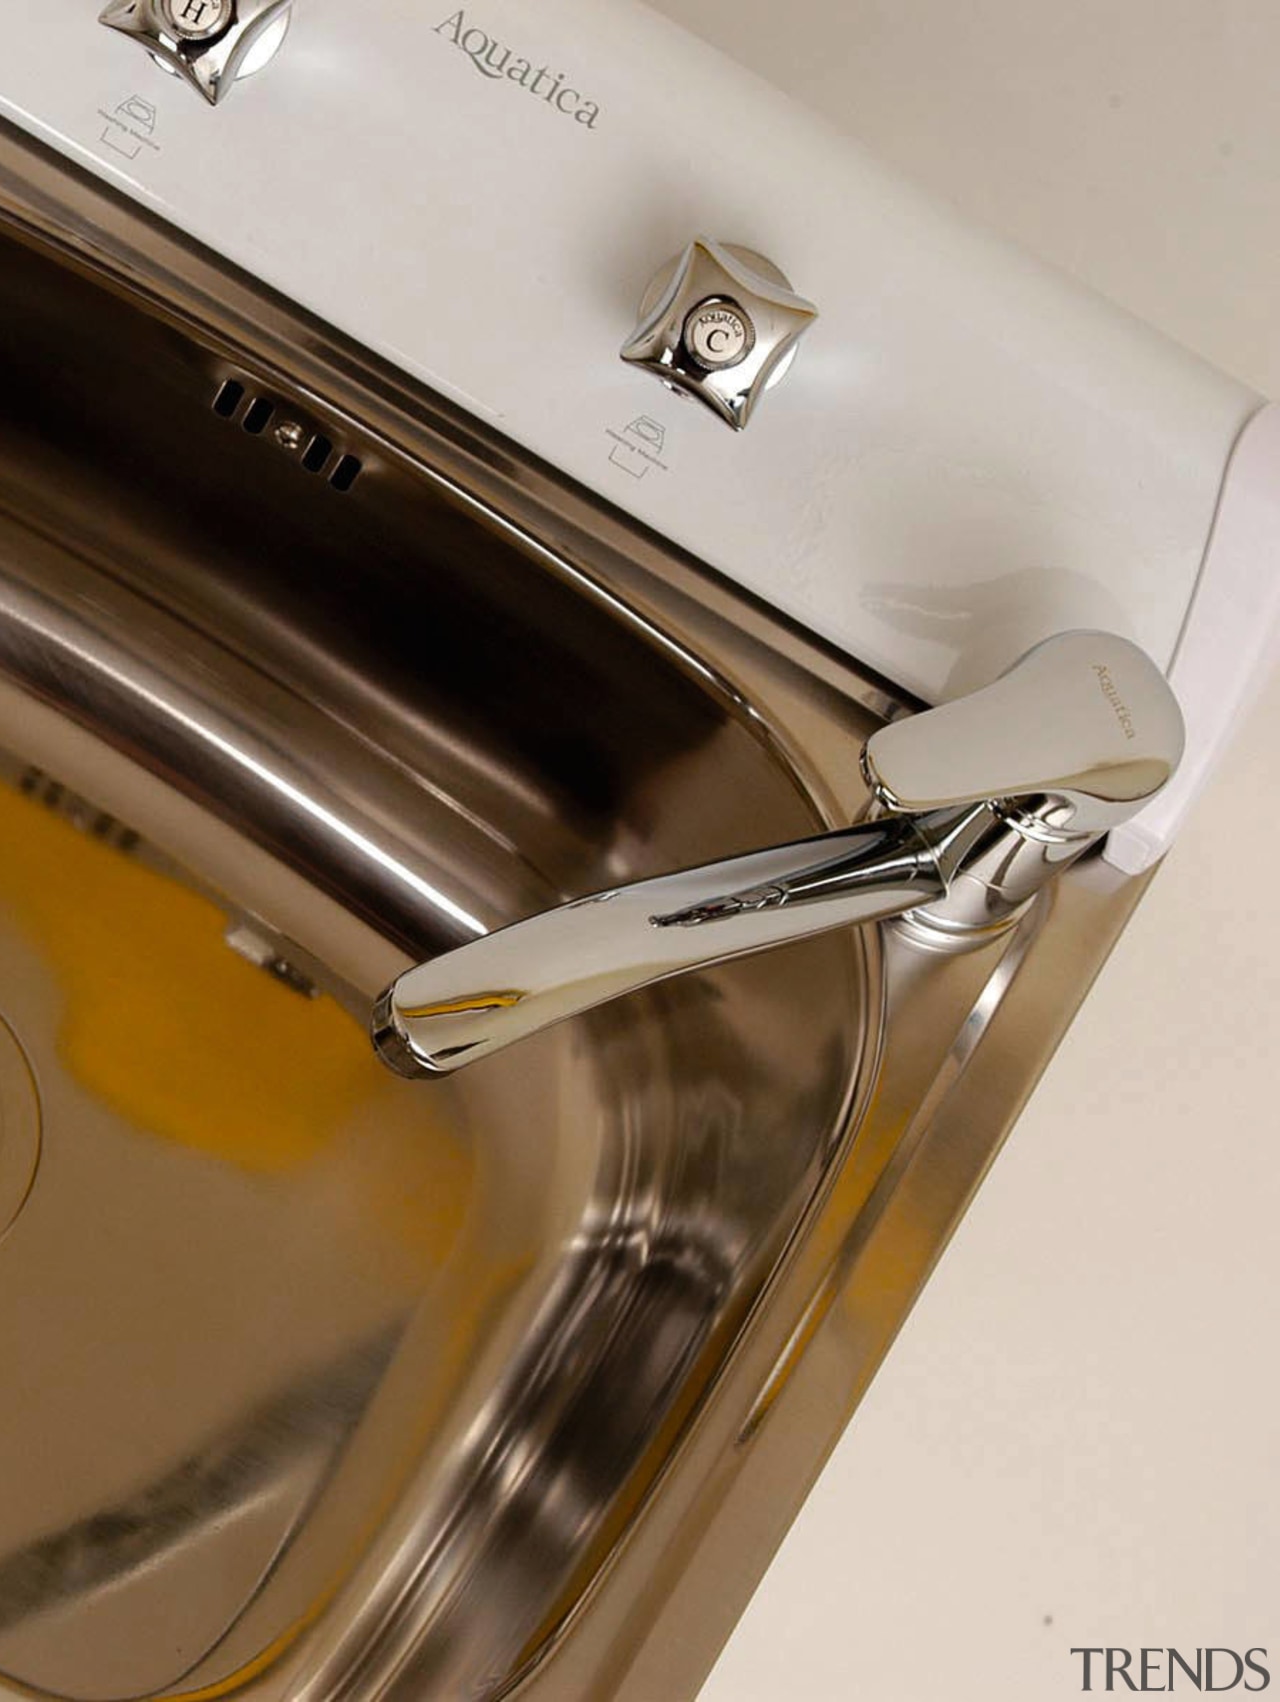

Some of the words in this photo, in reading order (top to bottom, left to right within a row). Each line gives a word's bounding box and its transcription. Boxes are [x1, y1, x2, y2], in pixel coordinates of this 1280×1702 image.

[180, 0, 207, 25] H
[431, 10, 600, 130] Aquatica
[706, 329, 729, 353] C
